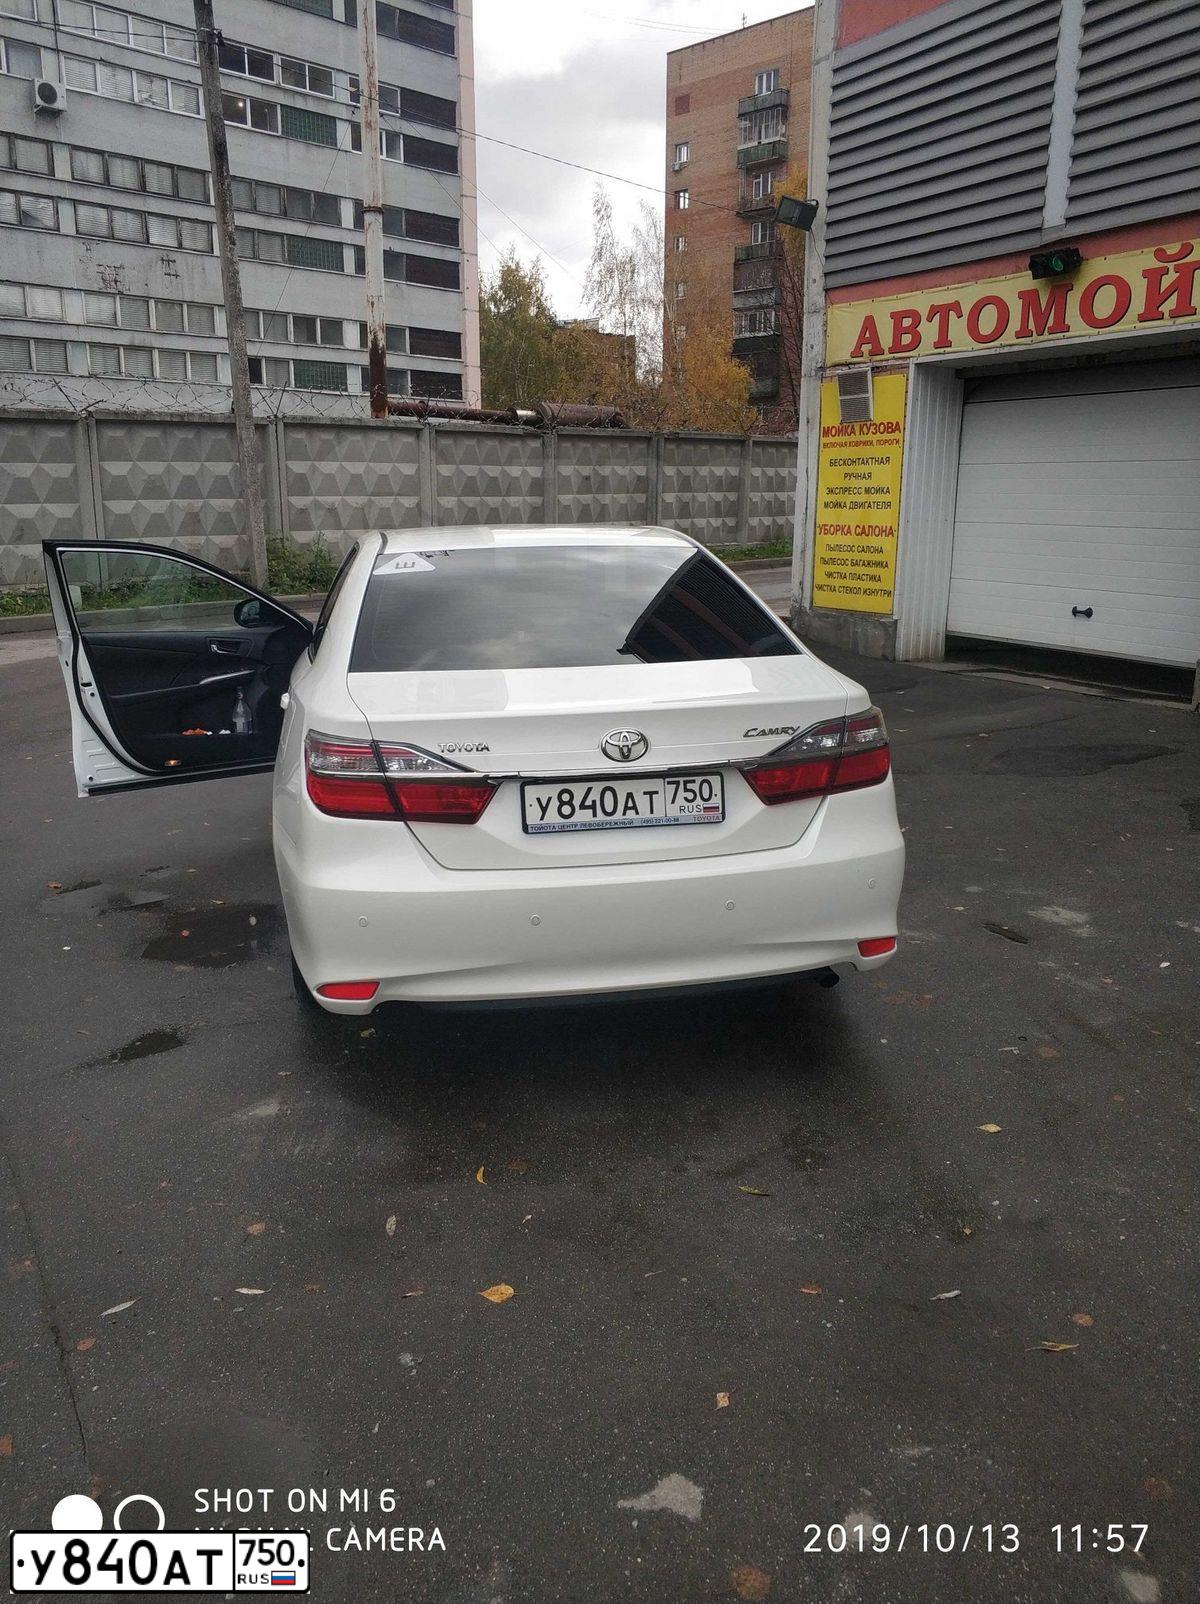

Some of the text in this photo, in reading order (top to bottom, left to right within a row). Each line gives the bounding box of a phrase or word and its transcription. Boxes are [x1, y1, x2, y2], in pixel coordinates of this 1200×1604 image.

[850, 242, 1200, 358] АВТОМОЙ
[822, 421, 902, 438] МОЙКА КУЗОВА
[823, 441, 848, 449] ВКЛЮЧАЯ
[876, 438, 900, 446] ПОРОГИ
[829, 456, 891, 467] БЕСКОНТАКТНАЯ
[843, 471, 873, 481] РУЧНАЯ
[826, 485, 891, 496] ЭКСПРЕСС МОЙКА
[823, 499, 892, 511] МОЙКА ДВИГАТЕЛЯ
[818, 523, 894, 538] УБОРКА САЛОНА
[825, 543, 884, 554] ПЫЛЕСОС САЛОНА
[819, 557, 889, 569] ПЫЛЕСОС БАГАЖНИКА
[824, 571, 882, 583] ЧИСТКА ПЛАСТИКА
[815, 583, 892, 598] ЧИСТКА СТЕКОЛ ИЗНУТРИ
[743, 725, 801, 738] CAMRY
[438, 742, 490, 753] TOYOTA
[666, 778, 713, 804] 750
[679, 804, 702, 814] RUS
[530, 824, 557, 832] ТОЙОТА
[557, 823, 579, 831] ЦЕНТР
